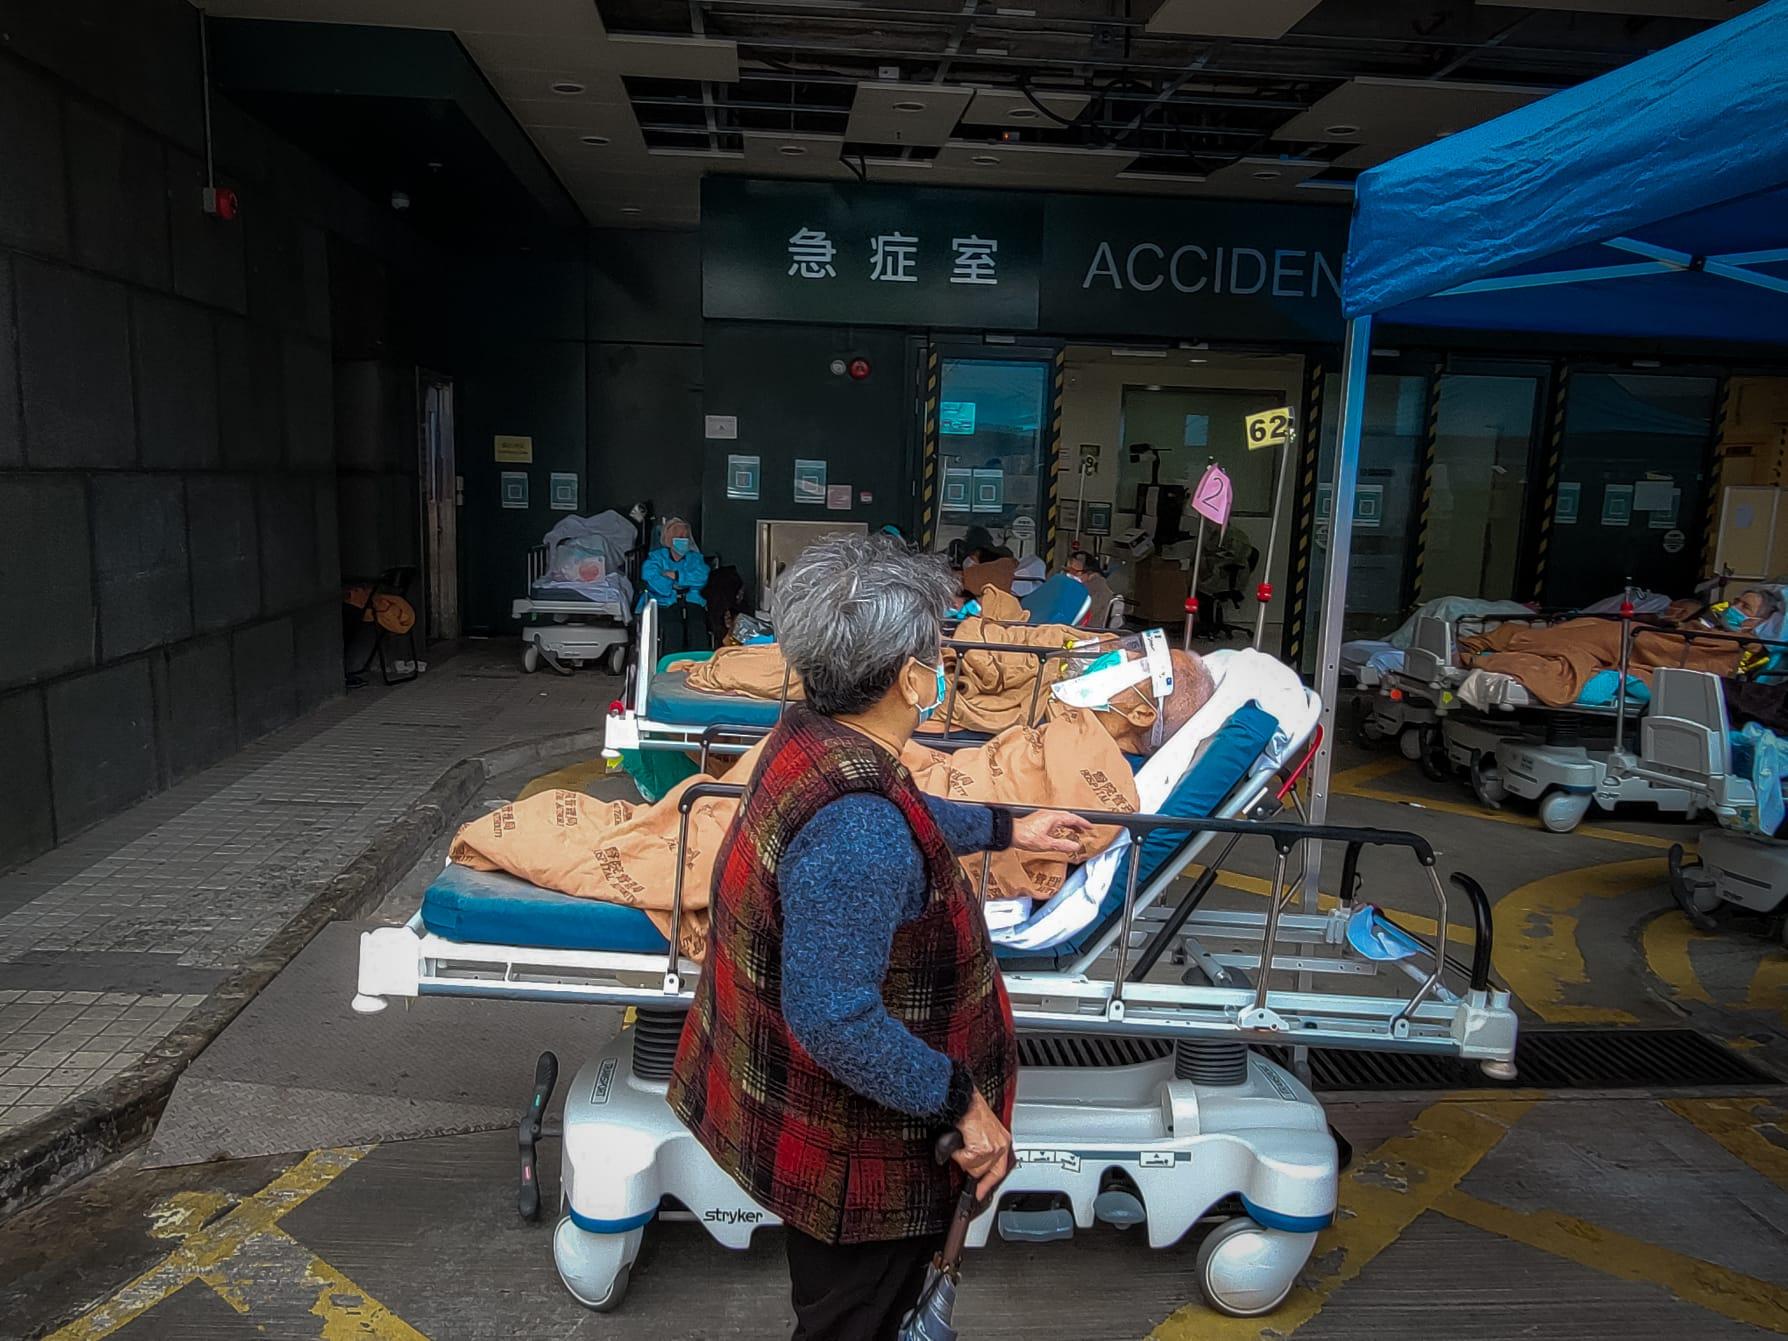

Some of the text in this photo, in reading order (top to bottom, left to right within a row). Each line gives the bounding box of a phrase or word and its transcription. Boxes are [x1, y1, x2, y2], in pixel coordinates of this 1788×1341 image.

[787, 227, 999, 285] 急症室
[1249, 414, 1288, 443] 62
[1201, 476, 1224, 513] 2
[703, 1207, 764, 1225] stryker
